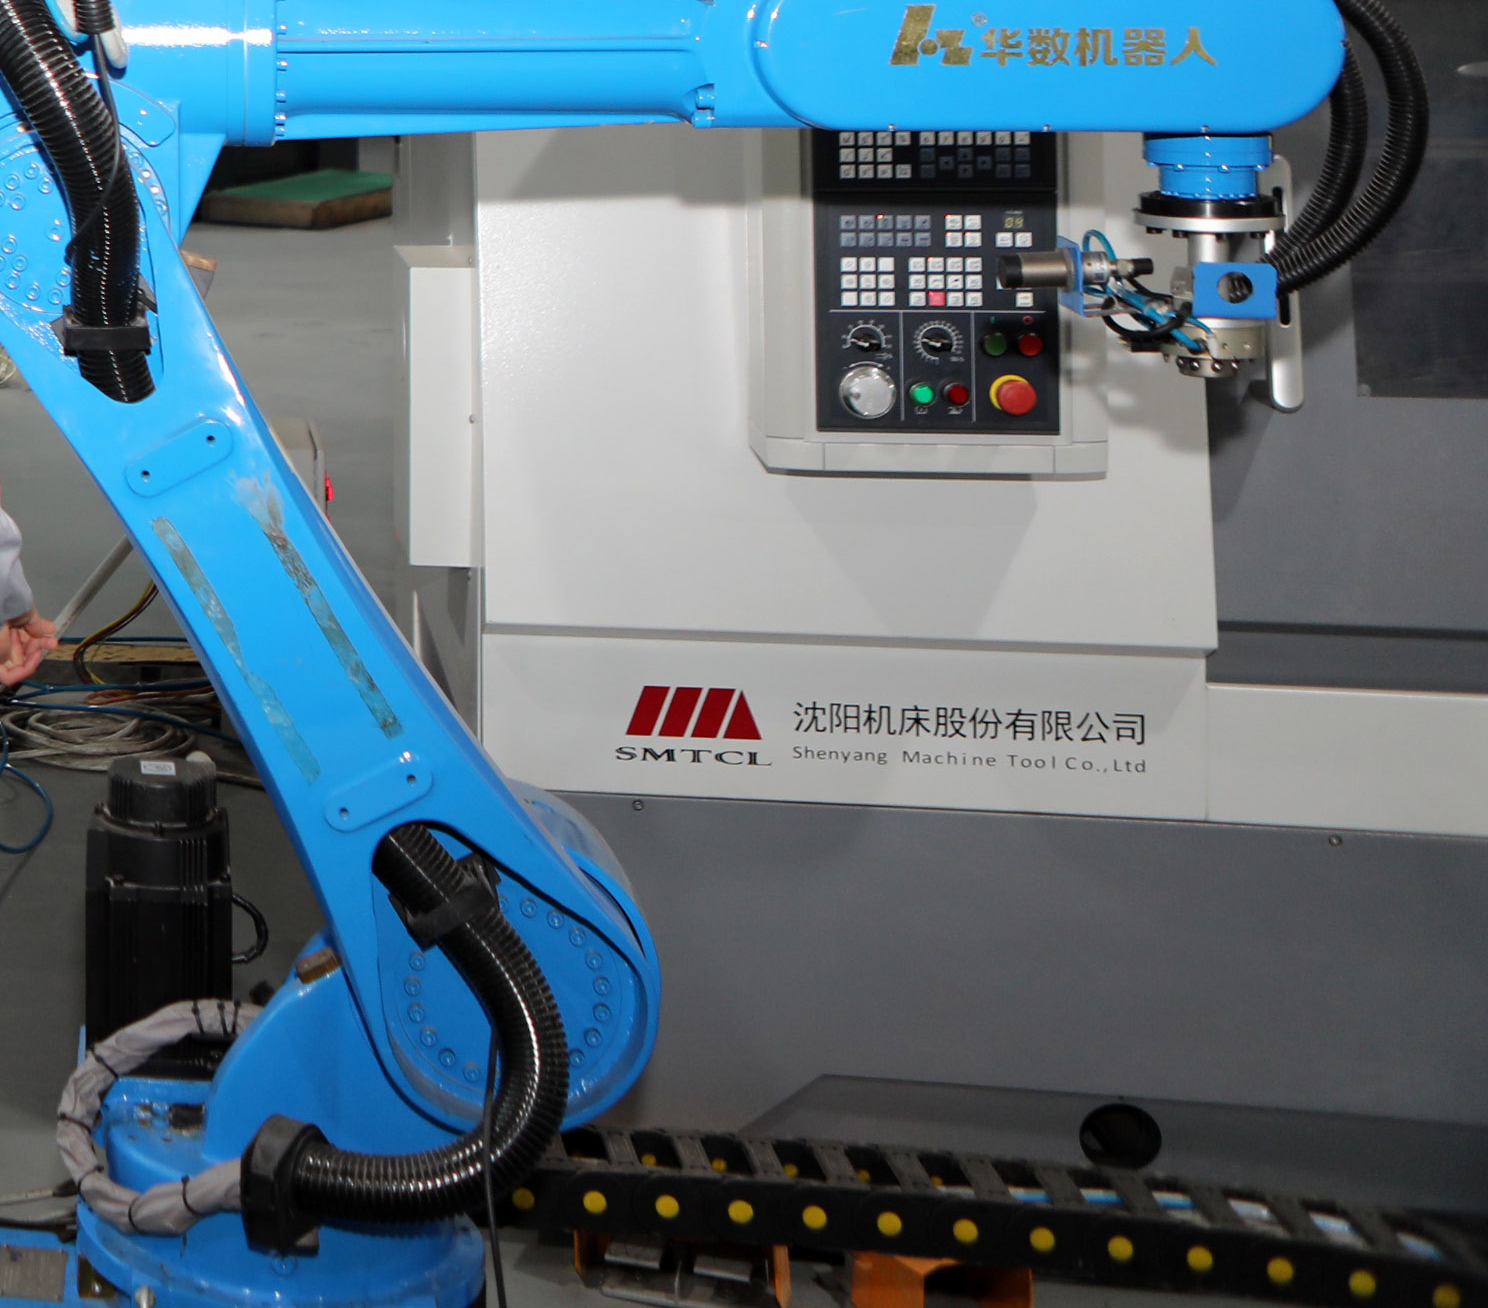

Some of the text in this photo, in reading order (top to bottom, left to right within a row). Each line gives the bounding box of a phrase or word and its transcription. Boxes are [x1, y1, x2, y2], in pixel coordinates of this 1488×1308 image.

[980, 27, 1218, 67] 华数机器人
[792, 700, 1146, 746] 沈阳机床股份有限公司
[615, 746, 772, 767] SMTCL
[792, 745, 888, 766] Shenyang
[902, 749, 997, 768] Machine
[1008, 753, 1056, 770] Tool
